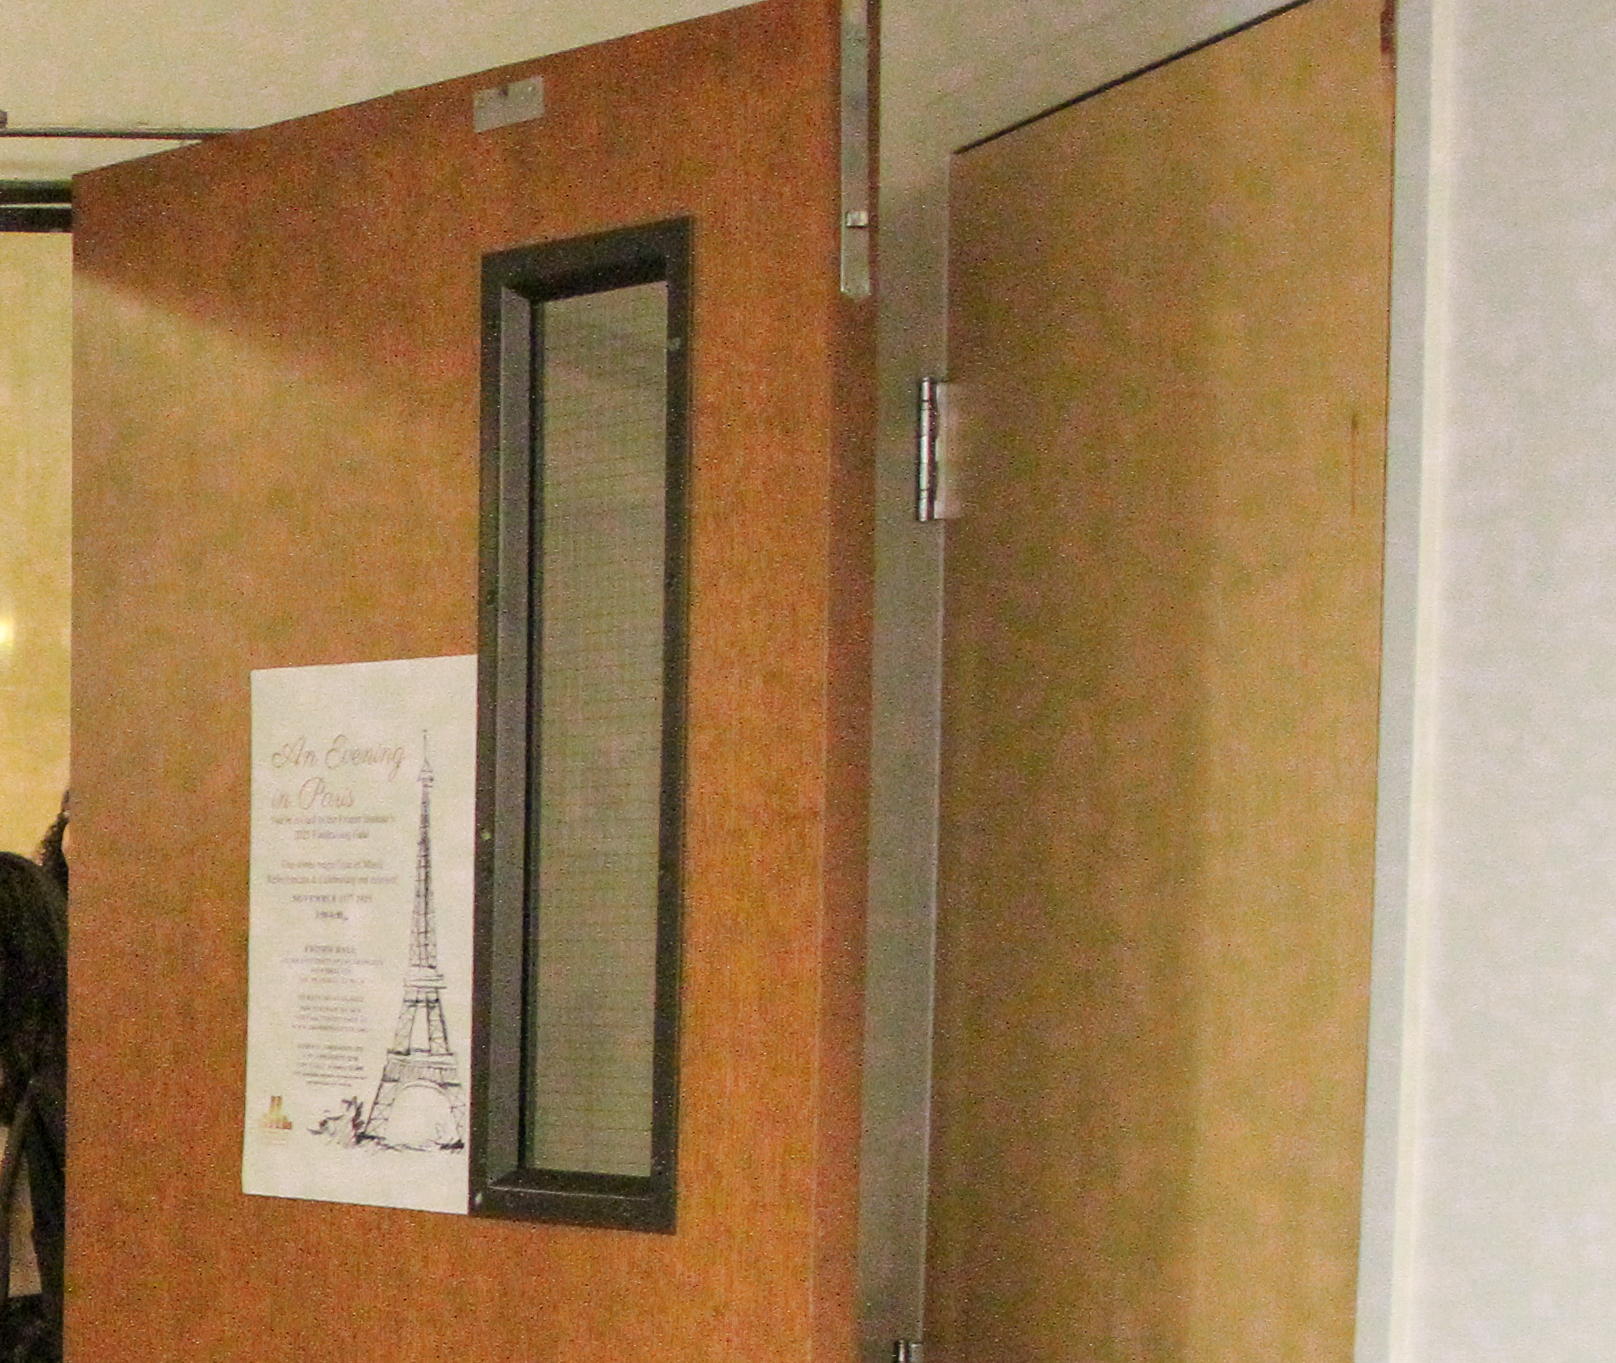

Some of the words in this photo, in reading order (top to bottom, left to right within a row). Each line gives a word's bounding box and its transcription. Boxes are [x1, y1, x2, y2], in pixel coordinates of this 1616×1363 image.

[271, 735, 317, 769] An
[325, 733, 405, 783] Evening
[271, 788, 290, 810] in
[298, 776, 356, 811] Paris
